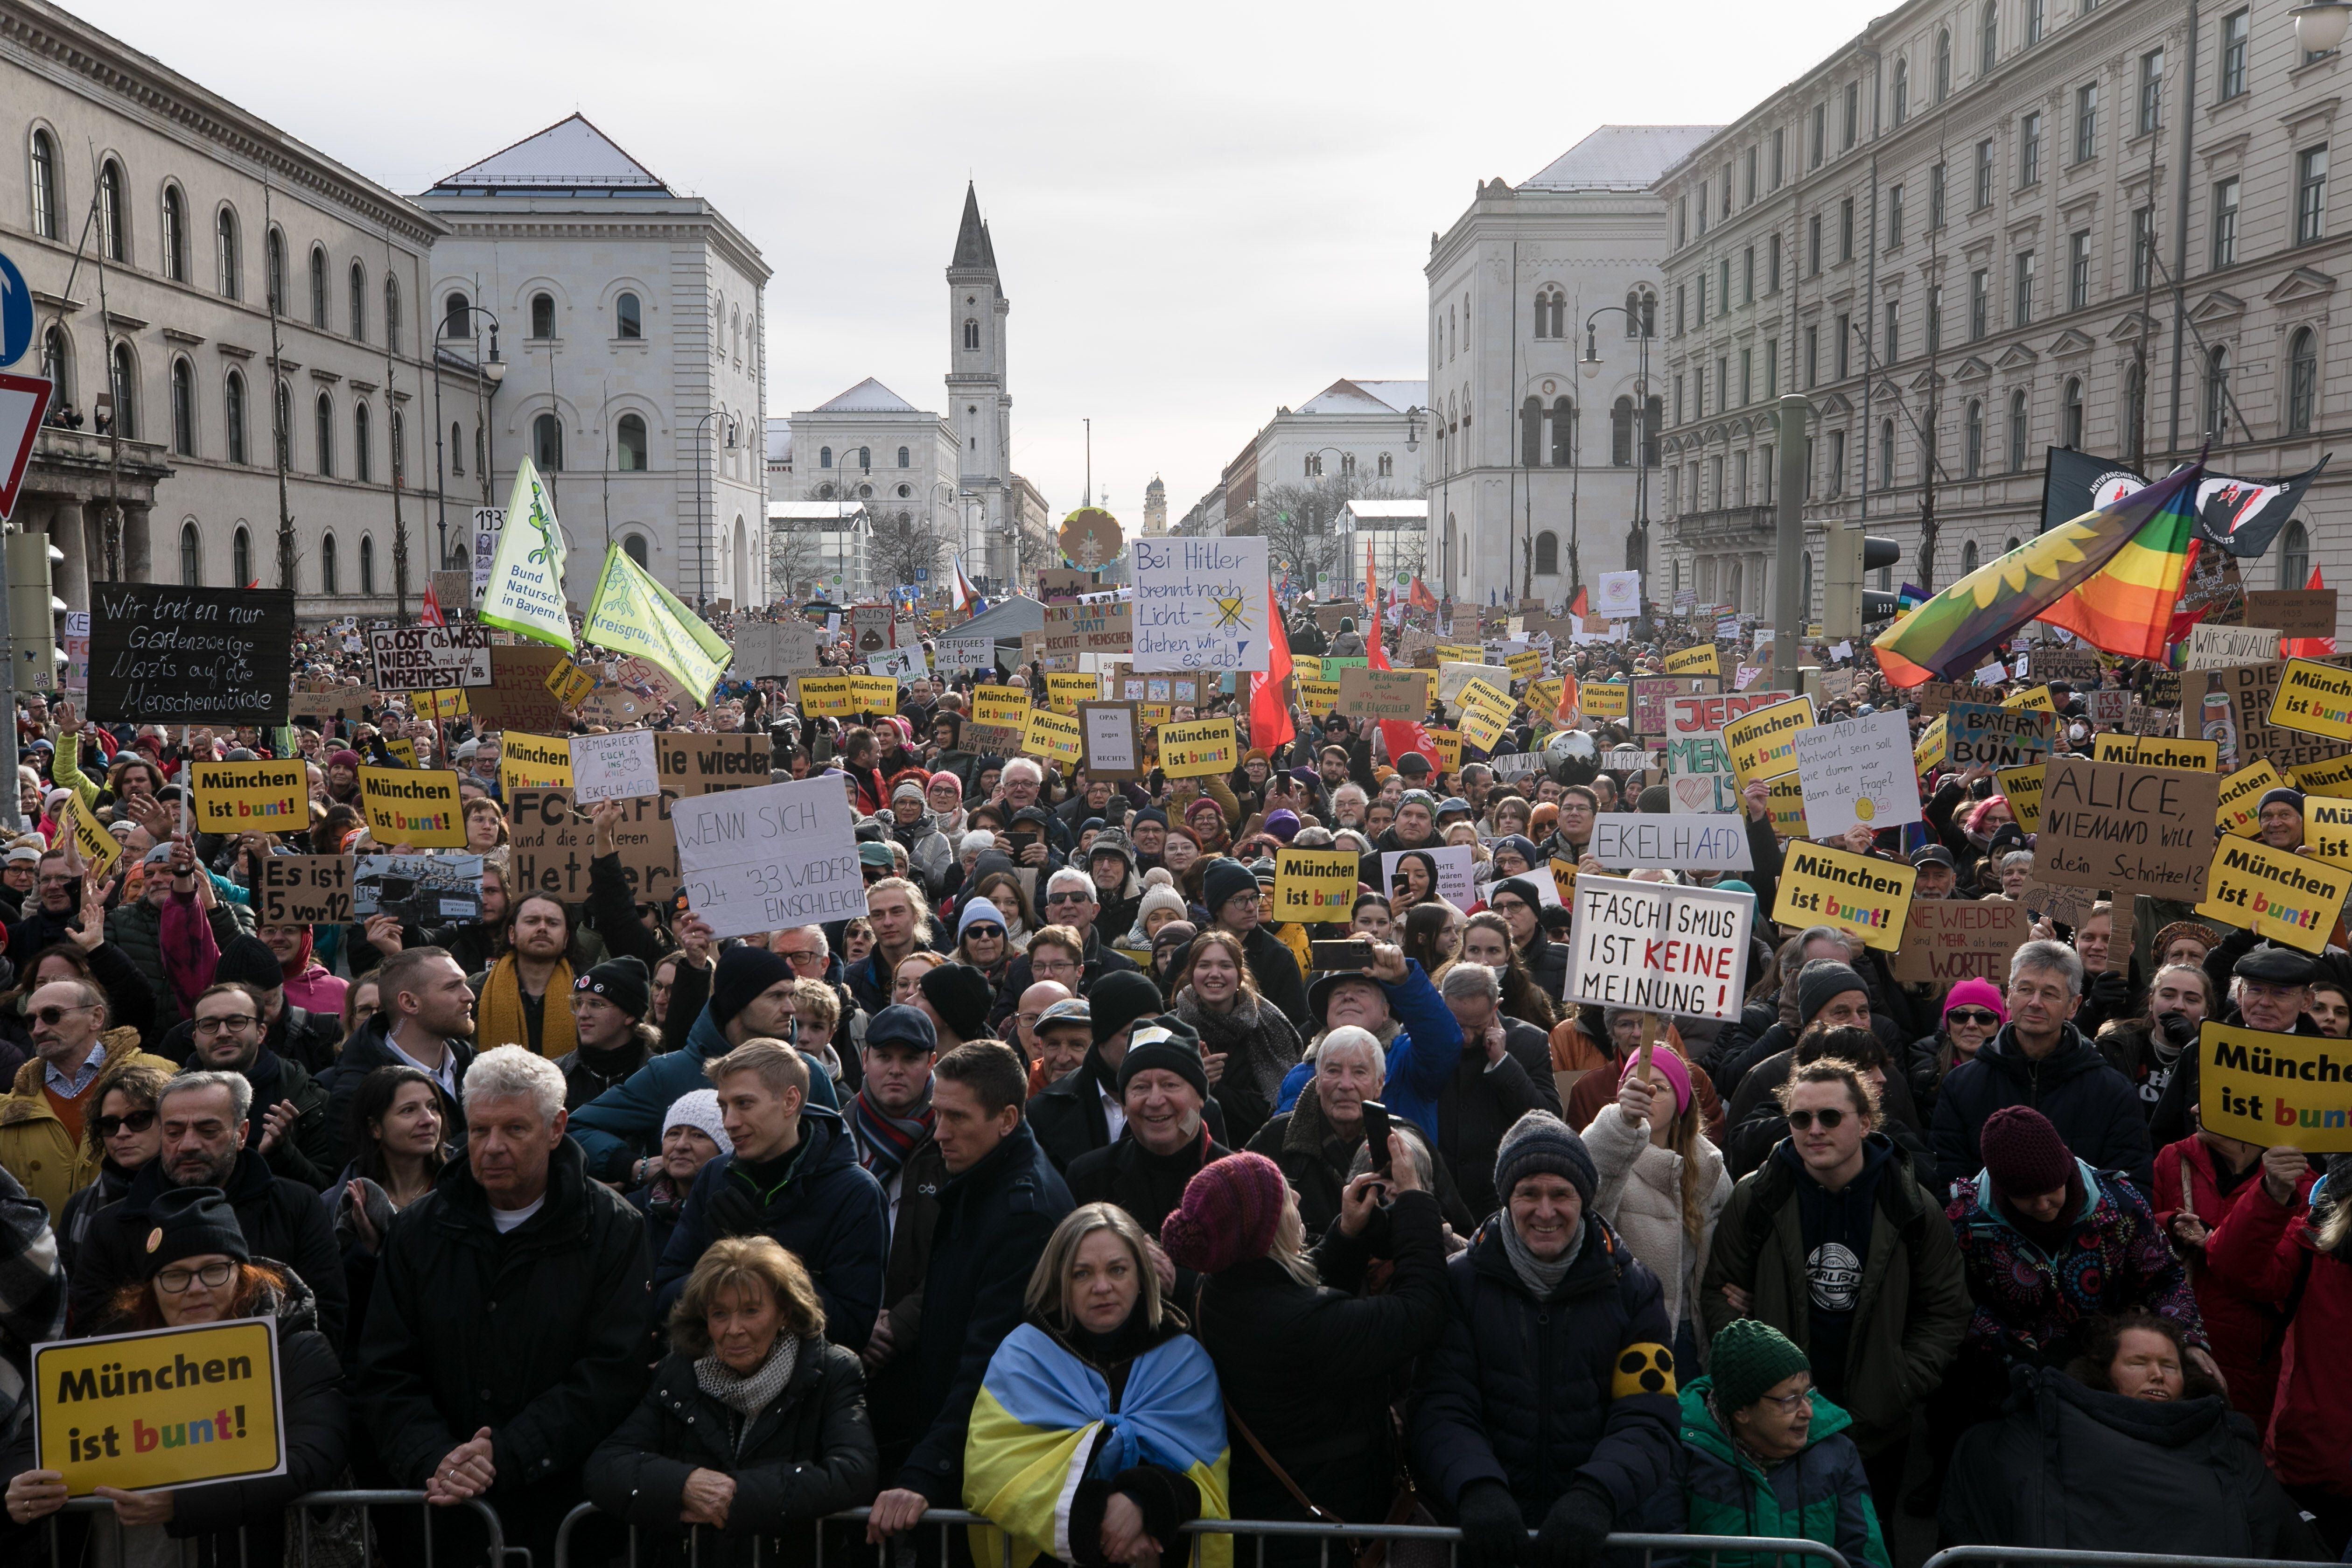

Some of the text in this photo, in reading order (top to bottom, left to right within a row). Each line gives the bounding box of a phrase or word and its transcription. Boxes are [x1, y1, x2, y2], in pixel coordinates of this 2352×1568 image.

[1136, 542, 1248, 570] Bei Hitler
[511, 565, 543, 584] Bund
[1139, 576, 1242, 598] brennt noch
[103, 592, 265, 623] Wir nur
[502, 594, 555, 622] in Bayern
[2254, 595, 2280, 606] Nazis
[1072, 619, 1105, 633] STATT
[128, 626, 254, 658] Gartenzwerge
[375, 626, 490, 651] Ob OST WEST
[778, 632, 803, 645] Volk
[939, 639, 985, 650] REFUGEES
[1046, 632, 1133, 650] RECHTE MENSCHEN
[1139, 630, 1221, 653] drehen wir
[378, 650, 475, 668] NIEDER mit der
[870, 651, 899, 664] Umwelt
[938, 654, 985, 664] WELCOME
[1183, 653, 1201, 667] es
[1508, 653, 1538, 665] München
[2033, 658, 2093, 666] RECHTSRUTSCH!
[111, 651, 253, 689] Nazis auf die
[900, 668, 926, 681] halten!
[1520, 662, 1538, 673] bunt!
[2034, 665, 2093, 680] FCKNZS
[380, 667, 464, 688] NAZIPEST
[803, 681, 846, 693] München
[851, 680, 893, 692] München
[1051, 679, 1097, 689] München
[344, 685, 369, 697] WIEDER
[1381, 691, 1401, 700] Knie
[1586, 688, 1624, 697] München
[1636, 680, 1679, 695] NAZIS
[2161, 683, 2180, 692] sind
[120, 683, 273, 714] Menschenwürde
[308, 694, 330, 702] NAZIS
[807, 697, 847, 709] ist bunt!
[864, 695, 890, 707] bunt!
[1054, 694, 1064, 705] ist
[1350, 701, 1411, 713] IHR EINZELLER
[1599, 700, 1622, 709] bunt!
[2100, 693, 2118, 706] FCK
[978, 707, 1022, 721] ist bunt!
[2097, 706, 2124, 719] NZS
[1164, 727, 1230, 744] München
[1732, 713, 1805, 749] München
[1796, 721, 1878, 748] Wenn AfD die
[1968, 713, 2044, 739] BAYERN
[579, 735, 640, 752] REMIGRIERT
[968, 733, 1004, 745] SCHIEBT
[1987, 735, 2010, 743] IST
[505, 742, 568, 766] München
[600, 750, 625, 761] EUCH
[697, 737, 770, 775] wieder
[959, 741, 1014, 757] DEN AB
[1168, 747, 1229, 766] ist bunt!
[1799, 743, 1869, 766] Antwort sein
[1953, 741, 2048, 766] BUNT
[608, 761, 621, 769] INS
[1498, 752, 1545, 773] ONE WORLD
[1602, 752, 1652, 770] ONE PEOPLE
[202, 770, 297, 789] München
[605, 768, 626, 778] KNIE
[1801, 761, 1879, 783] wie dumm war
[366, 777, 450, 799] München
[1806, 770, 1895, 802] dann die Frage?
[2051, 766, 2186, 822] ALICE,
[238, 798, 295, 817] bunt!
[396, 811, 450, 831] bunt!
[674, 801, 817, 848] WENN SICH
[2048, 809, 2148, 845] NIEMAND
[515, 828, 577, 847] und die
[1598, 824, 1739, 860] EKELHAfD
[266, 860, 346, 887] Es ist
[1284, 859, 1354, 877] München
[1793, 854, 1903, 896] München
[2051, 847, 2205, 892] dein Schnitzel?
[2223, 848, 2336, 900] München
[691, 856, 858, 908] '24 '33 WIEDER
[266, 891, 285, 921] 5
[764, 889, 866, 923] EINSCHLEICHT
[1287, 888, 1350, 906] ist bunt!
[1583, 890, 1736, 938] FASCHISMUS
[1791, 886, 1891, 929] ist bunt!
[2252, 891, 2321, 931] bunt!
[1939, 905, 2017, 930] WIEDER
[1913, 933, 2010, 948] sind MEHR als leere
[1589, 933, 1734, 980] IST KEINE
[1929, 951, 2001, 980] WORTE
[1582, 973, 1705, 1014] MEINUNG
[57, 1353, 252, 1404] München
[68, 1405, 247, 1463] ist bunt!
